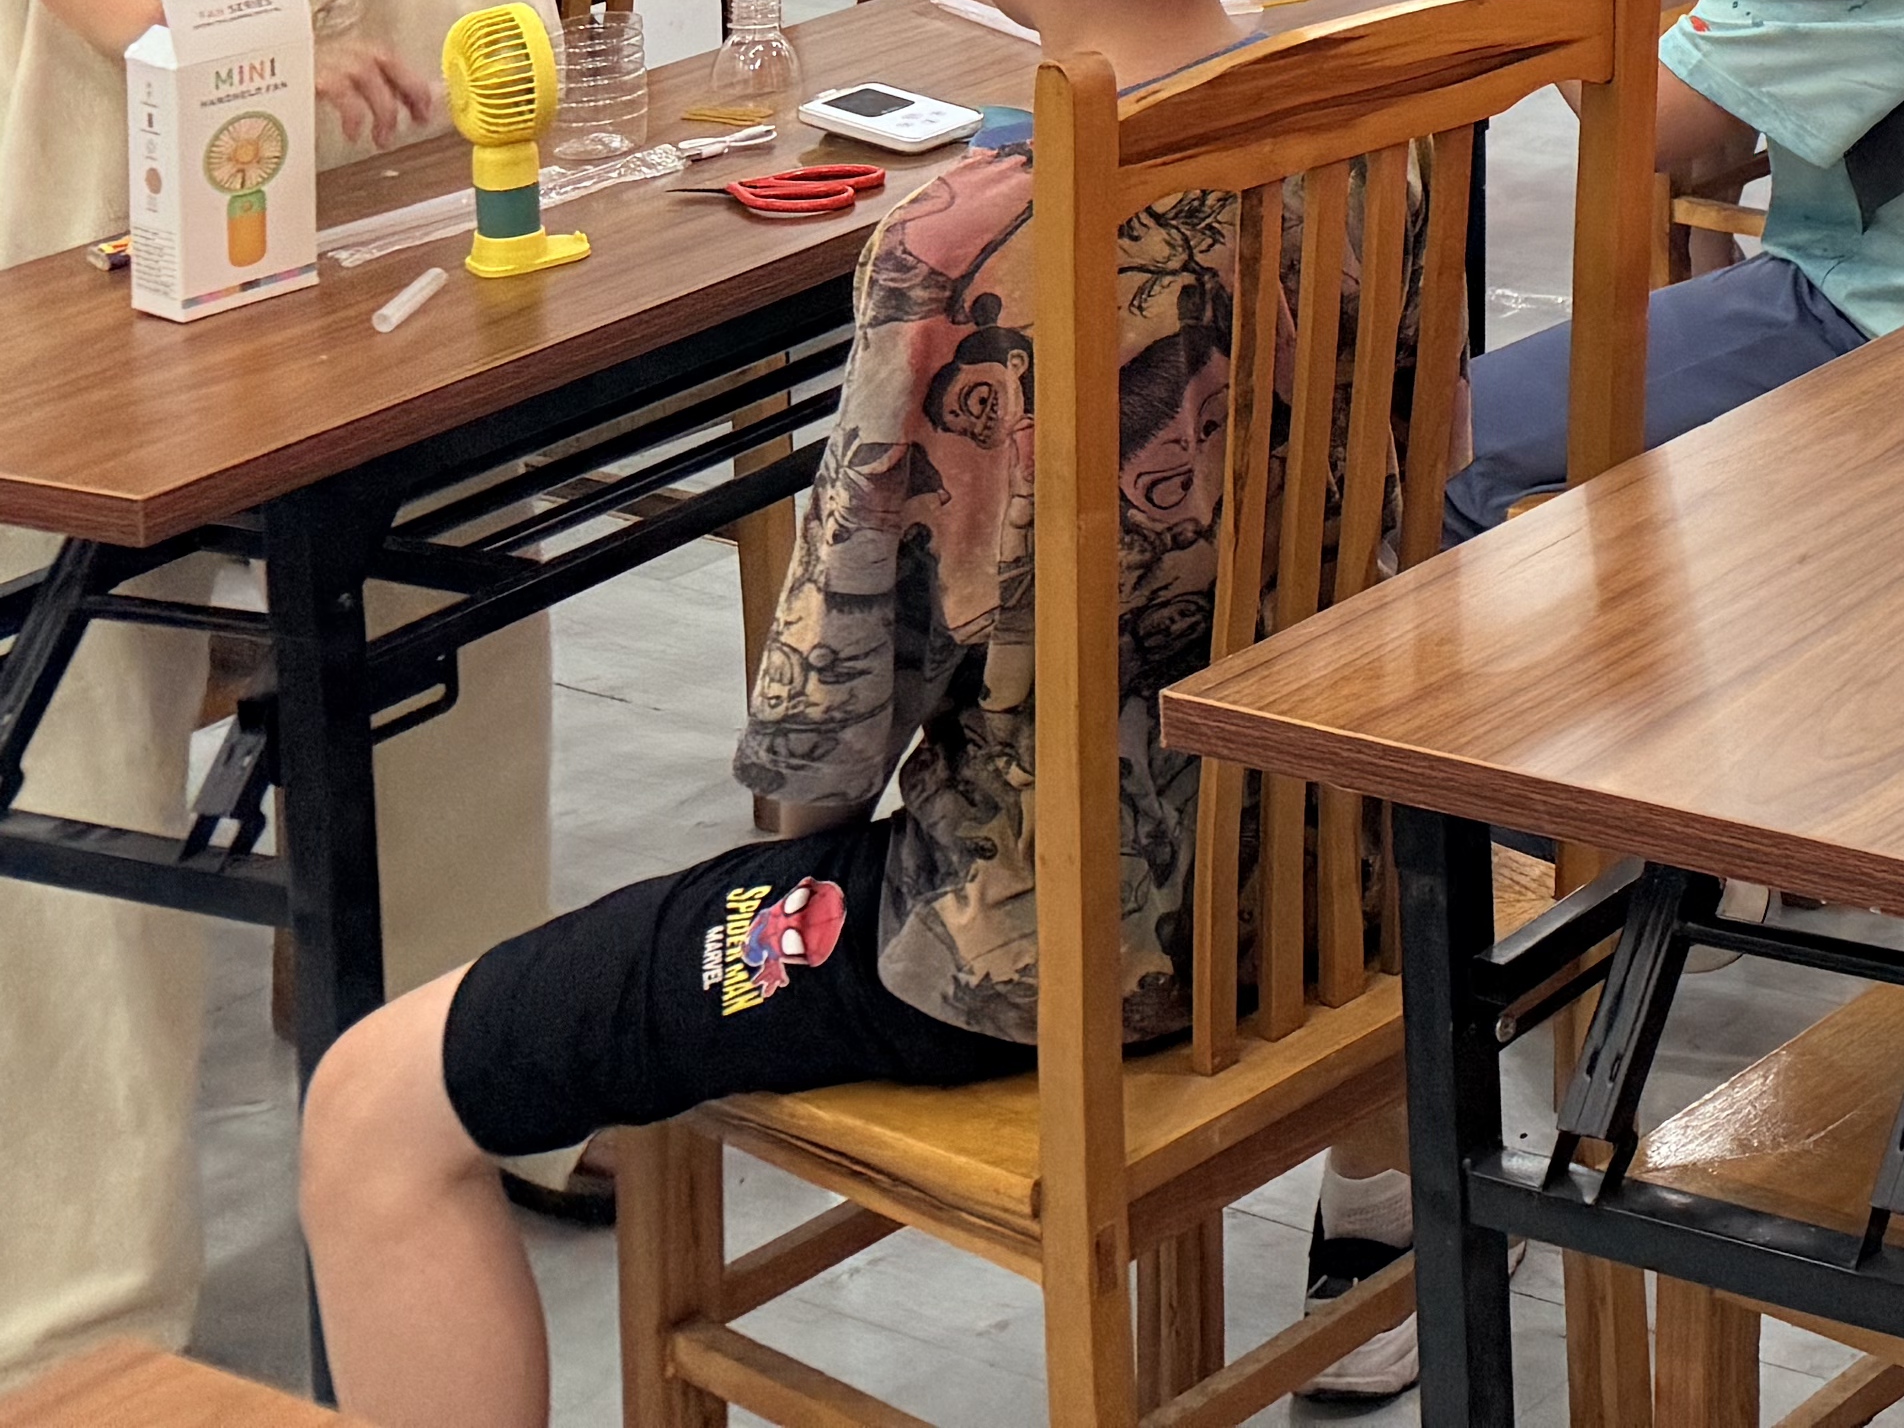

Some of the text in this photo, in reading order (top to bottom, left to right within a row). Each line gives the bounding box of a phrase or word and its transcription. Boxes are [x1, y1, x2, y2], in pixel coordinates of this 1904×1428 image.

[215, 57, 276, 91] MINI
[702, 925, 725, 991] MARVEL
[721, 961, 764, 1016] MAN
